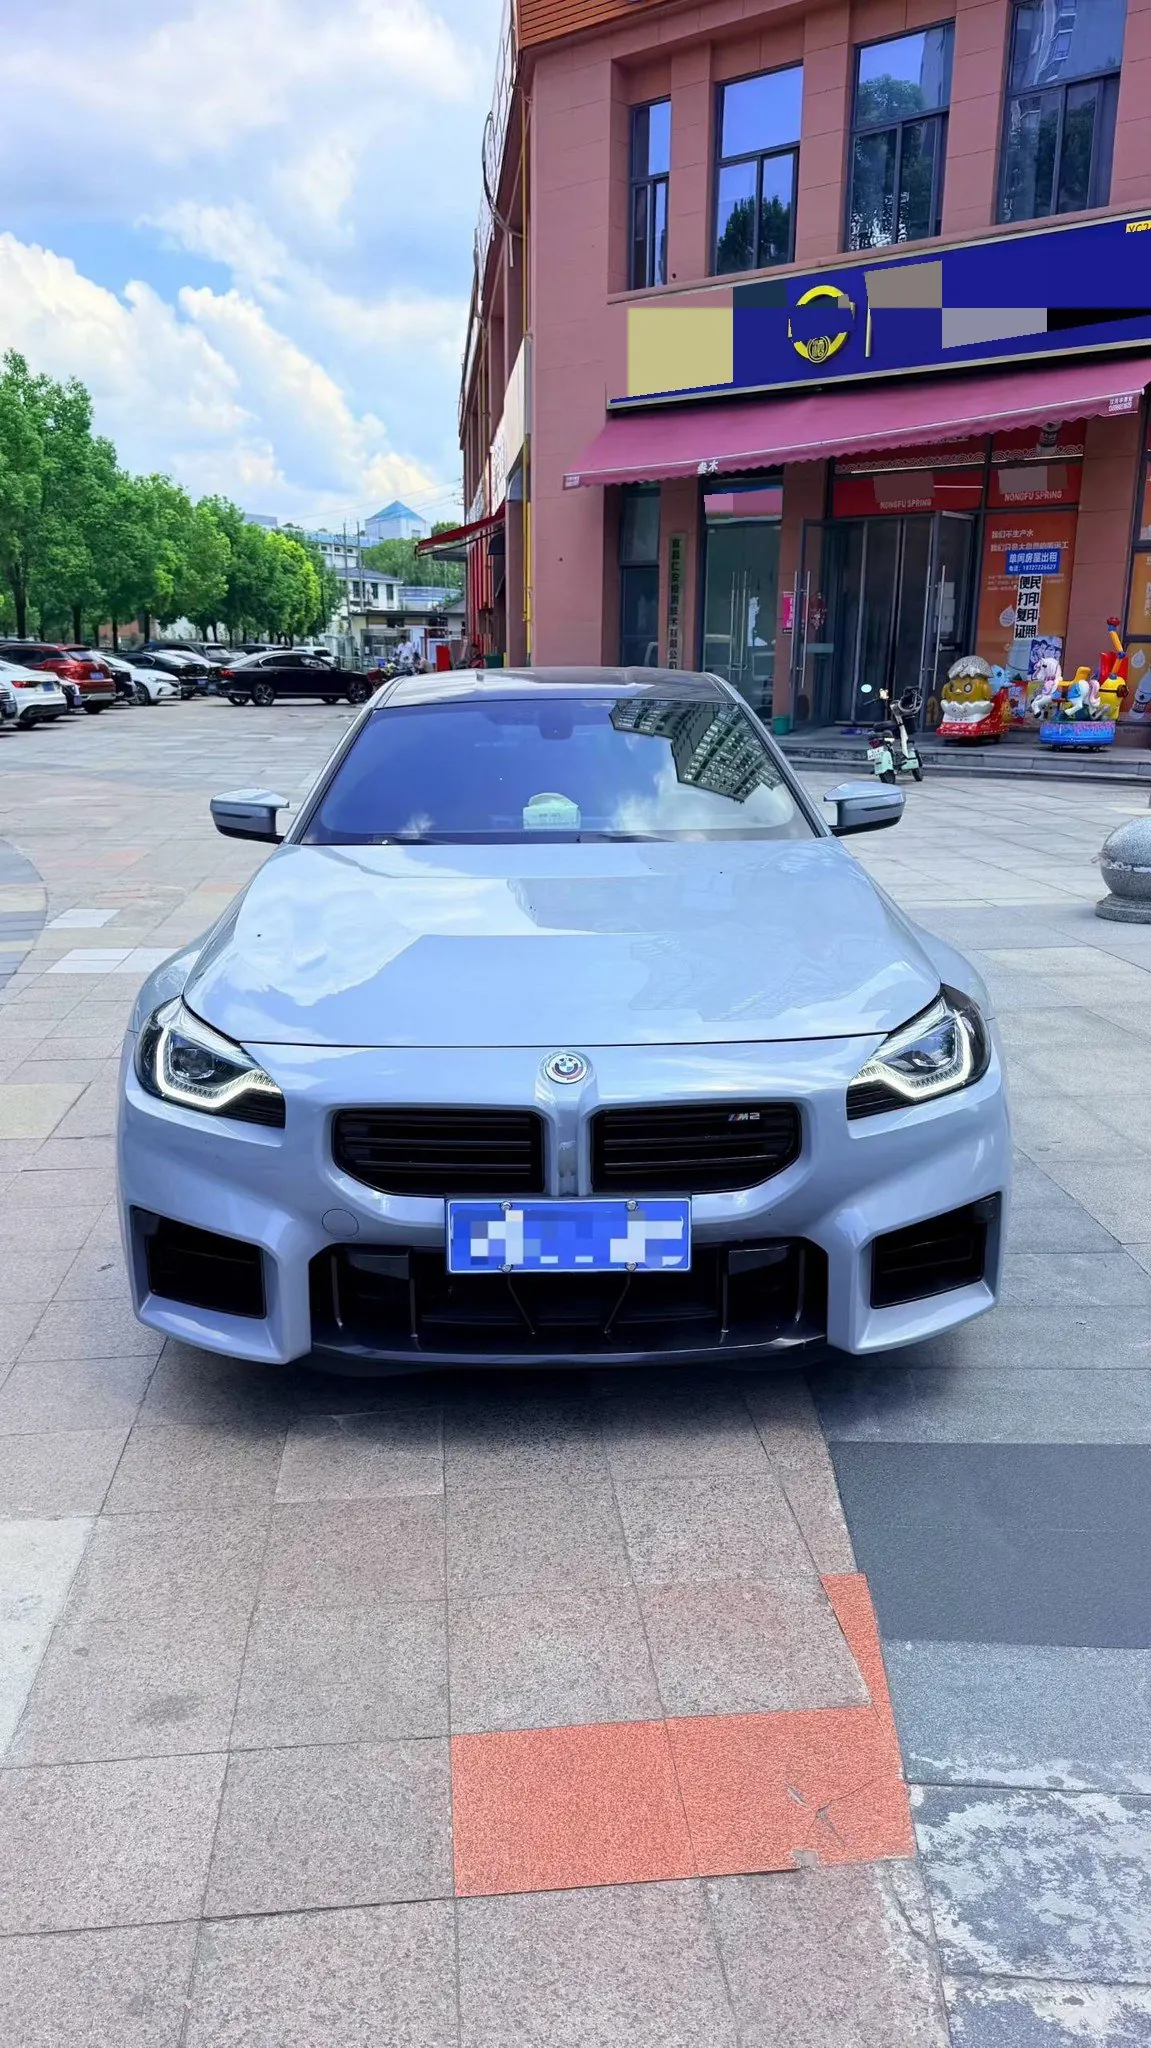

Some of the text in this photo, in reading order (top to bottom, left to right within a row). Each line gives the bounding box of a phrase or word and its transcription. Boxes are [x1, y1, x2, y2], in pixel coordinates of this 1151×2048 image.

[1004, 490, 1062, 501] NONGFU SPRING
[880, 499, 932, 509] NONGFU SPRING
[1019, 576, 1041, 589] 便民
[1018, 592, 1039, 606] 打印
[1016, 608, 1038, 622] 复印
[1014, 625, 1037, 638] 证照
